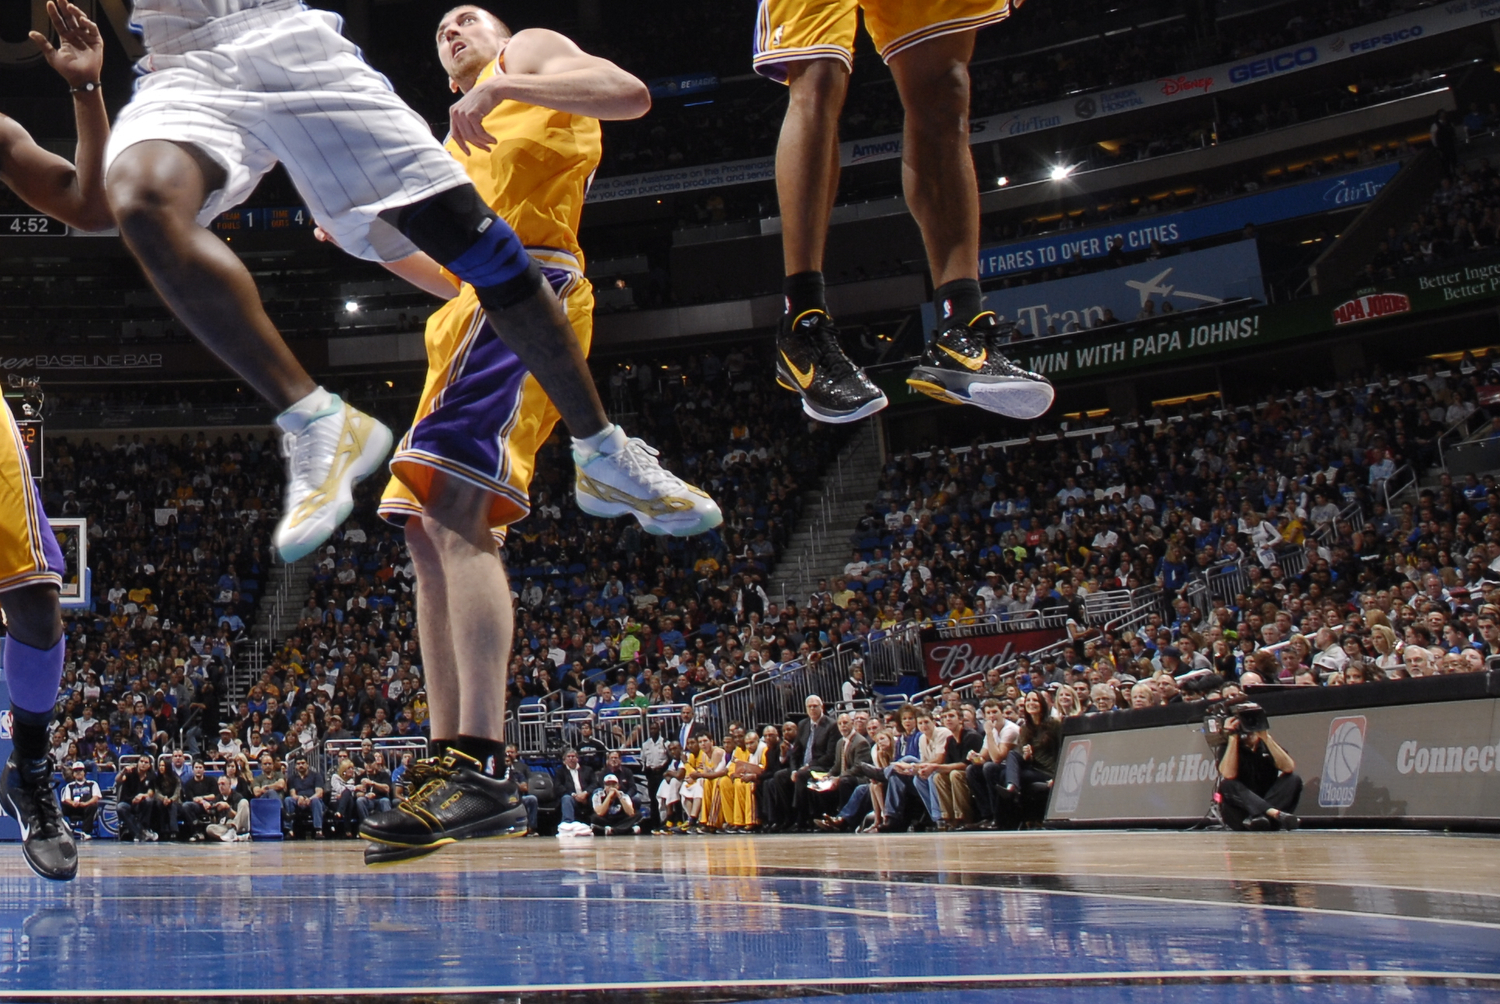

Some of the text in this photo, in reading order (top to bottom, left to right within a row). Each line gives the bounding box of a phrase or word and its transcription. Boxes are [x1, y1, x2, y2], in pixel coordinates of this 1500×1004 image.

[1349, 24, 1424, 54] PEPSICO
[1228, 46, 1318, 84] GEICO
[1101, 97, 1145, 113] HOSPITAL
[852, 139, 901, 158] Amway
[598, 189, 617, 201] you
[618, 186, 636, 197] can
[638, 181, 681, 197] purchase
[682, 175, 724, 191] products
[725, 172, 745, 183] and
[611, 176, 639, 189] Guest
[641, 170, 688, 185] Assistance
[703, 165, 720, 176] the
[9, 217, 50, 234] 4:52
[216, 220, 242, 231] FOULS
[221, 211, 254, 228] TEAM 1
[271, 209, 290, 219] TIME
[294, 209, 304, 226] 4
[271, 218, 290, 228] OUTS
[988, 249, 1035, 273] FARES
[1038, 244, 1058, 264] TO
[1060, 236, 1102, 260] OVER
[1127, 223, 1180, 248] CITIES
[1418, 271, 1462, 291] Better
[1442, 282, 1487, 301] Better
[1333, 294, 1410, 323] PAPA JOHNS
[1029, 347, 1069, 375] WIN
[1075, 340, 1127, 369] WITH
[1132, 331, 1182, 358] PAPA
[1187, 314, 1261, 348] JOHNS!
[35, 354, 123, 369] BASELINE
[123, 353, 163, 368] BAR
[1090, 757, 1155, 787] Connect
[1155, 755, 1175, 784] at
